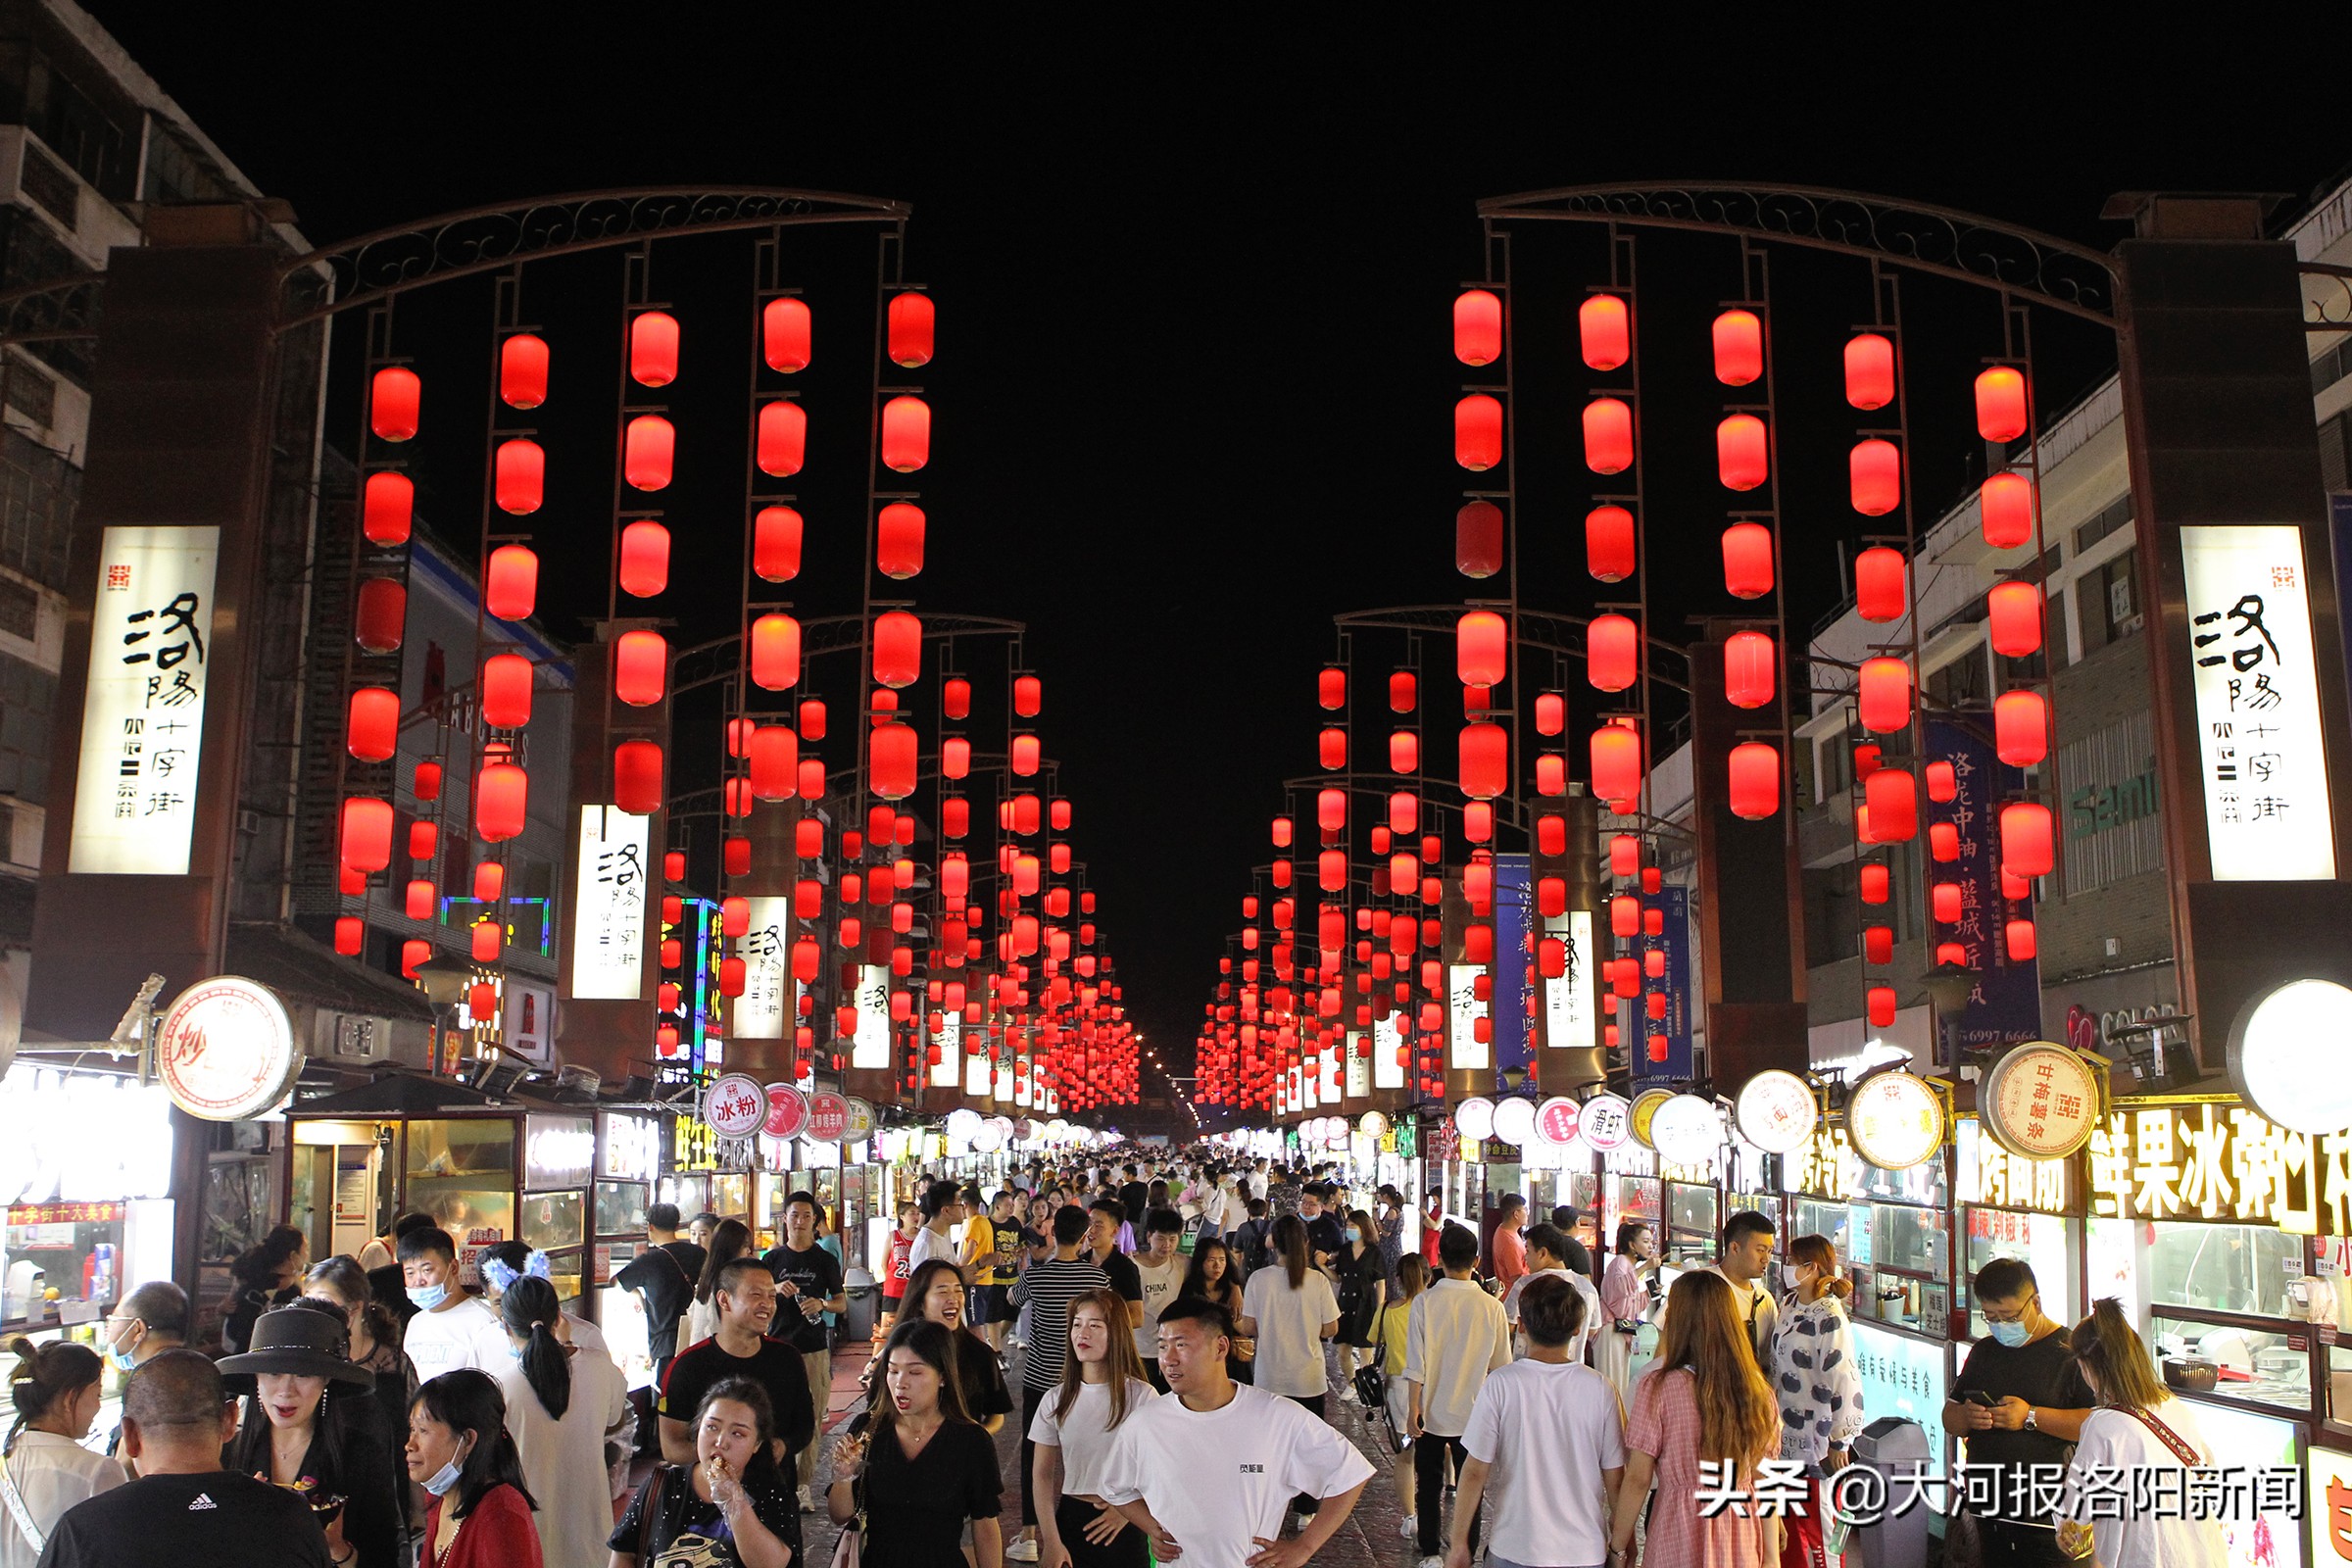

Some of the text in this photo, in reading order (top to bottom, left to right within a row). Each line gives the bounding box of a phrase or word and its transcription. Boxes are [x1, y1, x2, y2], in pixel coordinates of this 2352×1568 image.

[2070, 770, 2162, 842] Semi
[1969, 1030, 2037, 1042] 6997 6666
[715, 1095, 757, 1122] 冰粉
[2026, 1063, 2055, 1140] 甘梅薯条
[1145, 1283, 1167, 1293] CHINA
[188, 1502, 218, 1511] adidas
